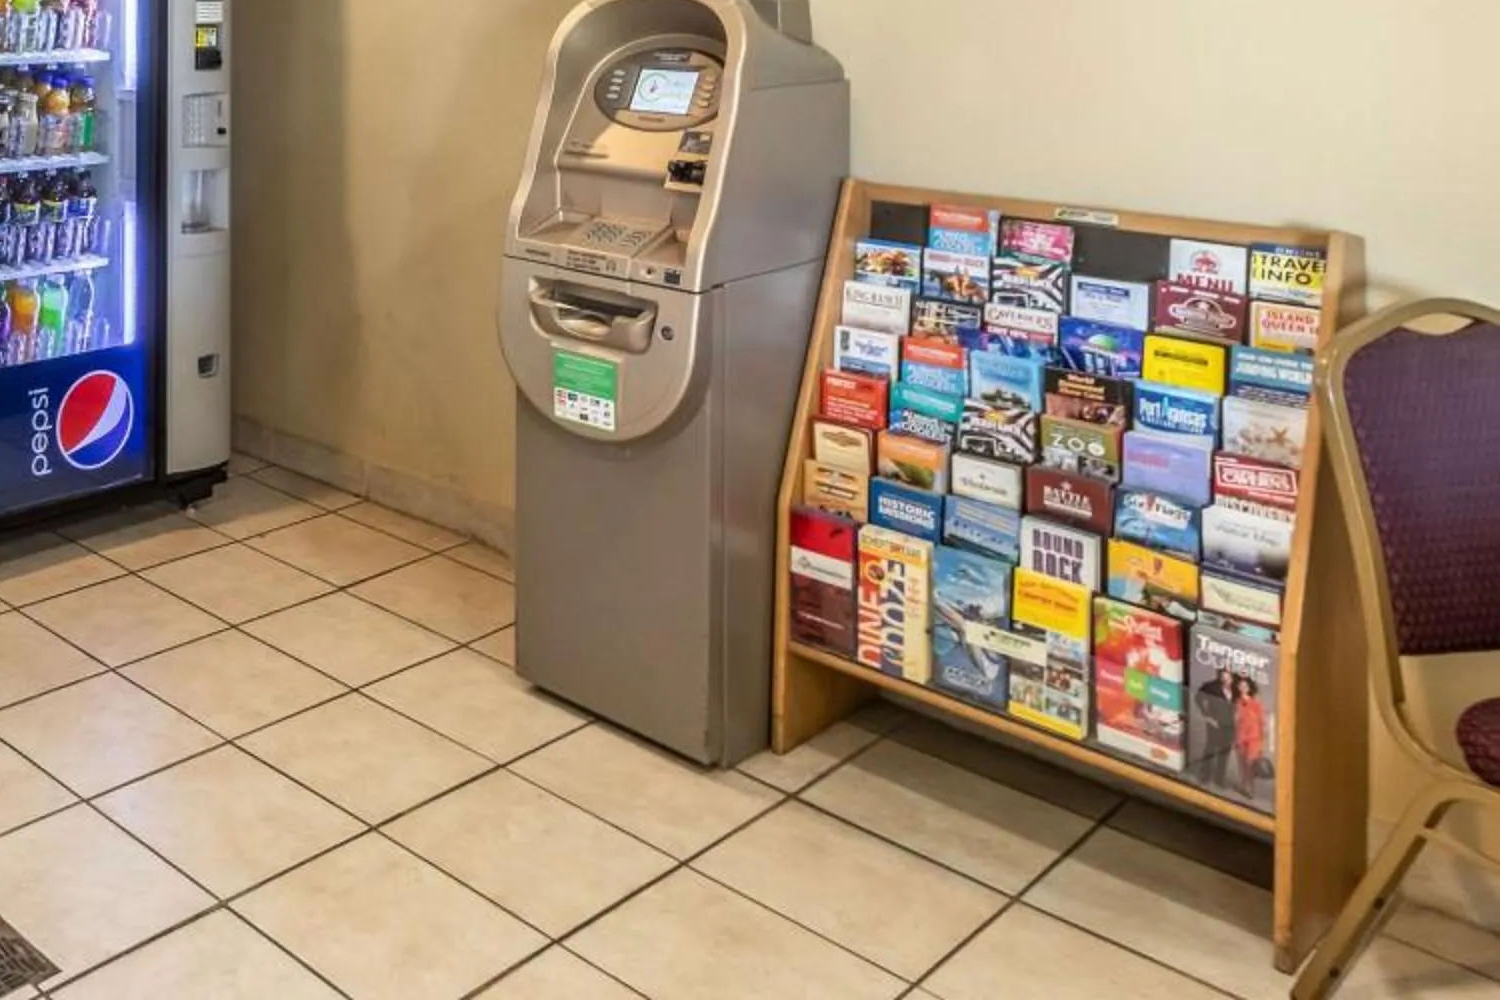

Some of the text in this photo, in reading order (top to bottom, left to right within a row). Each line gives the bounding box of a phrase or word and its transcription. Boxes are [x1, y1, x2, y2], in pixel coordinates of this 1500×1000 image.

[1261, 269, 1312, 286] INFO
[1261, 317, 1305, 333] QUEEN
[1266, 310, 1315, 325] ISLAND
[28, 387, 52, 477] pepsi
[1032, 529, 1084, 561] ROUND
[1032, 550, 1083, 585] ROCK
[858, 586, 882, 670] DINE
[1196, 633, 1270, 668] Tanger
